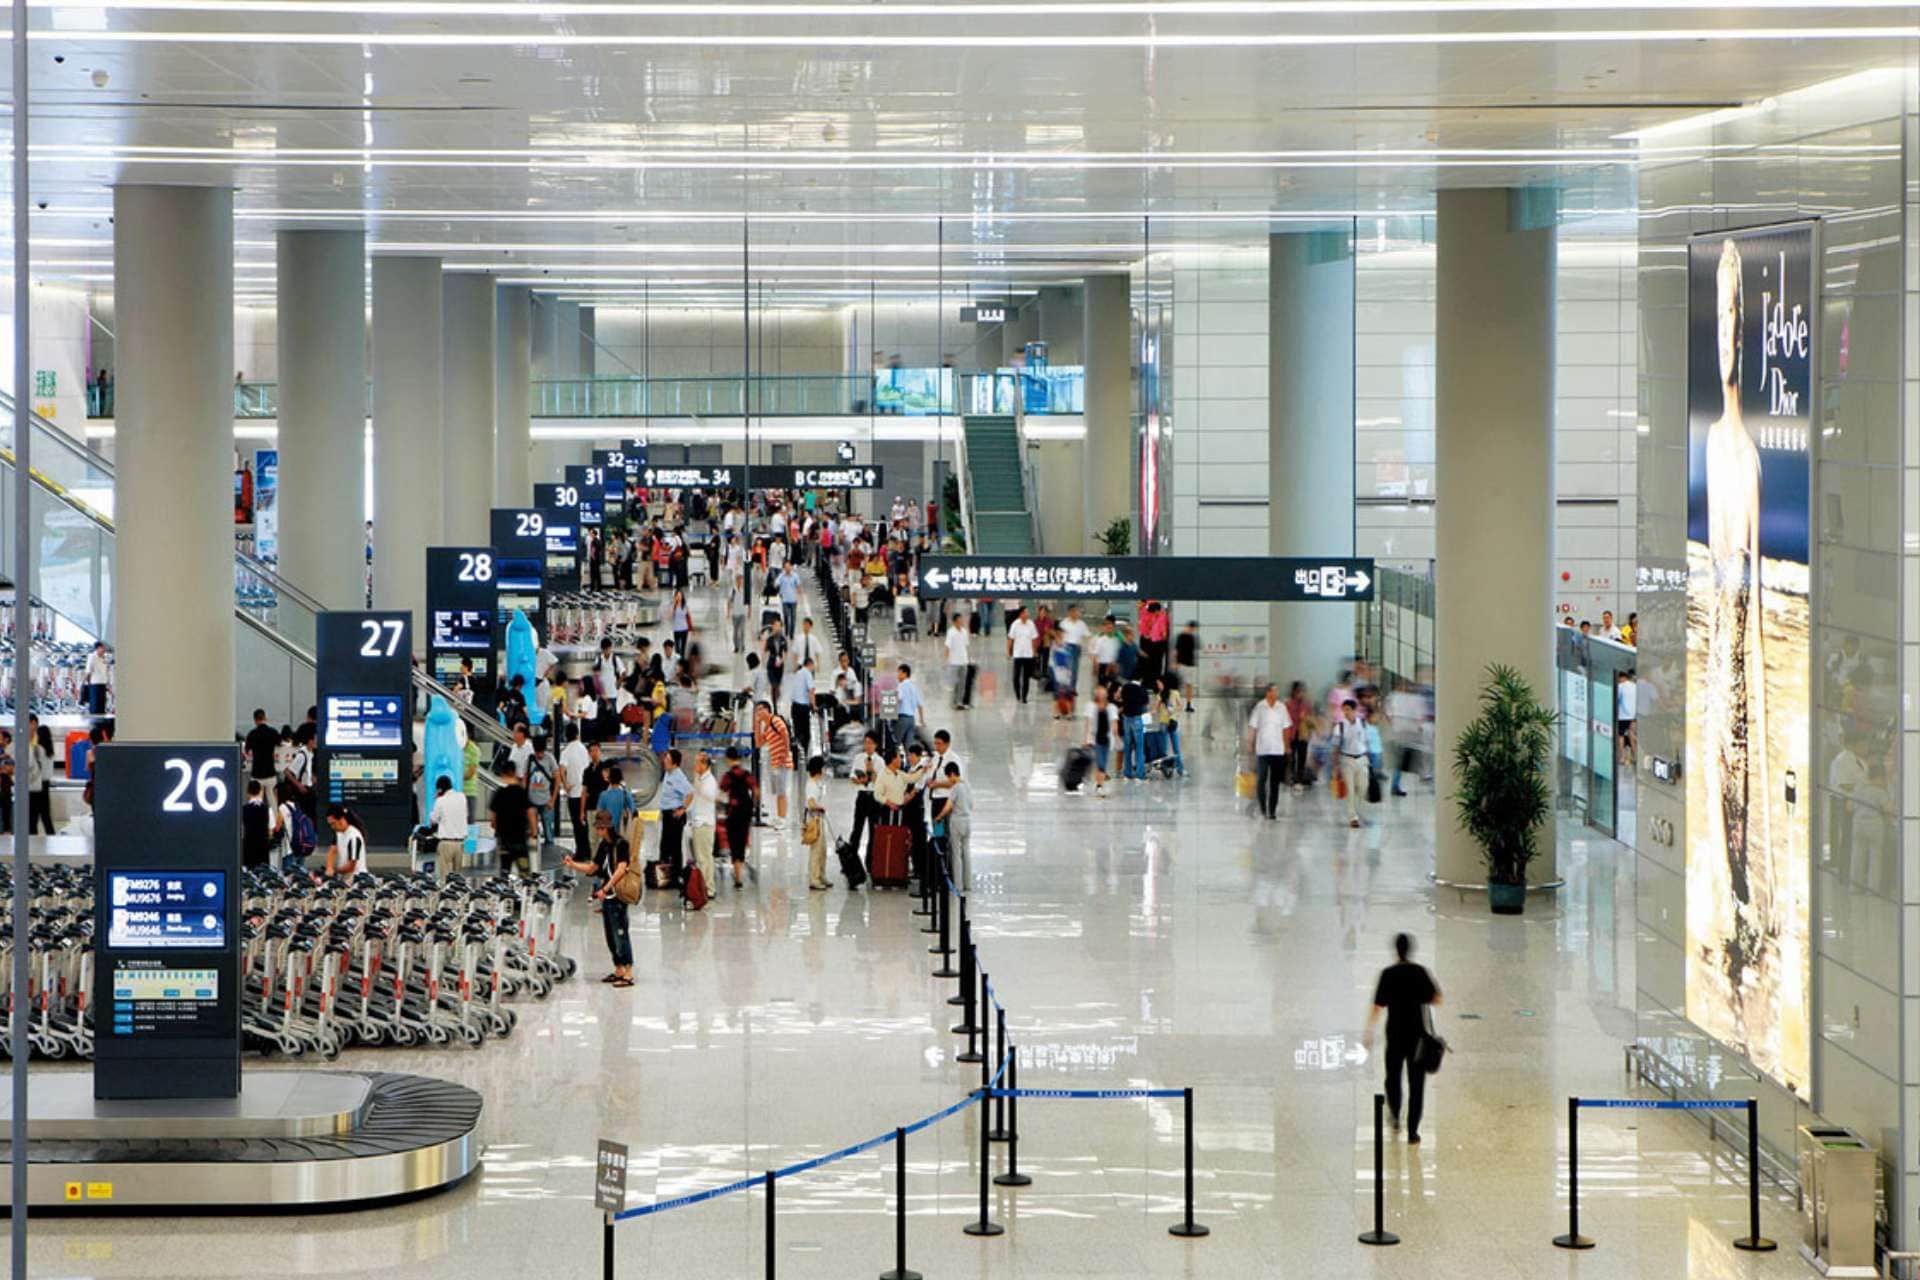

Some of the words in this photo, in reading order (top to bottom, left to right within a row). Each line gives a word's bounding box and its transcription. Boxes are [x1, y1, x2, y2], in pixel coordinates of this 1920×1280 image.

[1769, 366, 1799, 416] Dior
[607, 452, 624, 468] 32
[585, 468, 603, 486] 31
[712, 469, 731, 486] 34
[555, 486, 578, 507] 30
[516, 512, 543, 537] 29
[458, 553, 492, 582] 28
[360, 620, 404, 657] 27
[162, 757, 228, 812] 26
